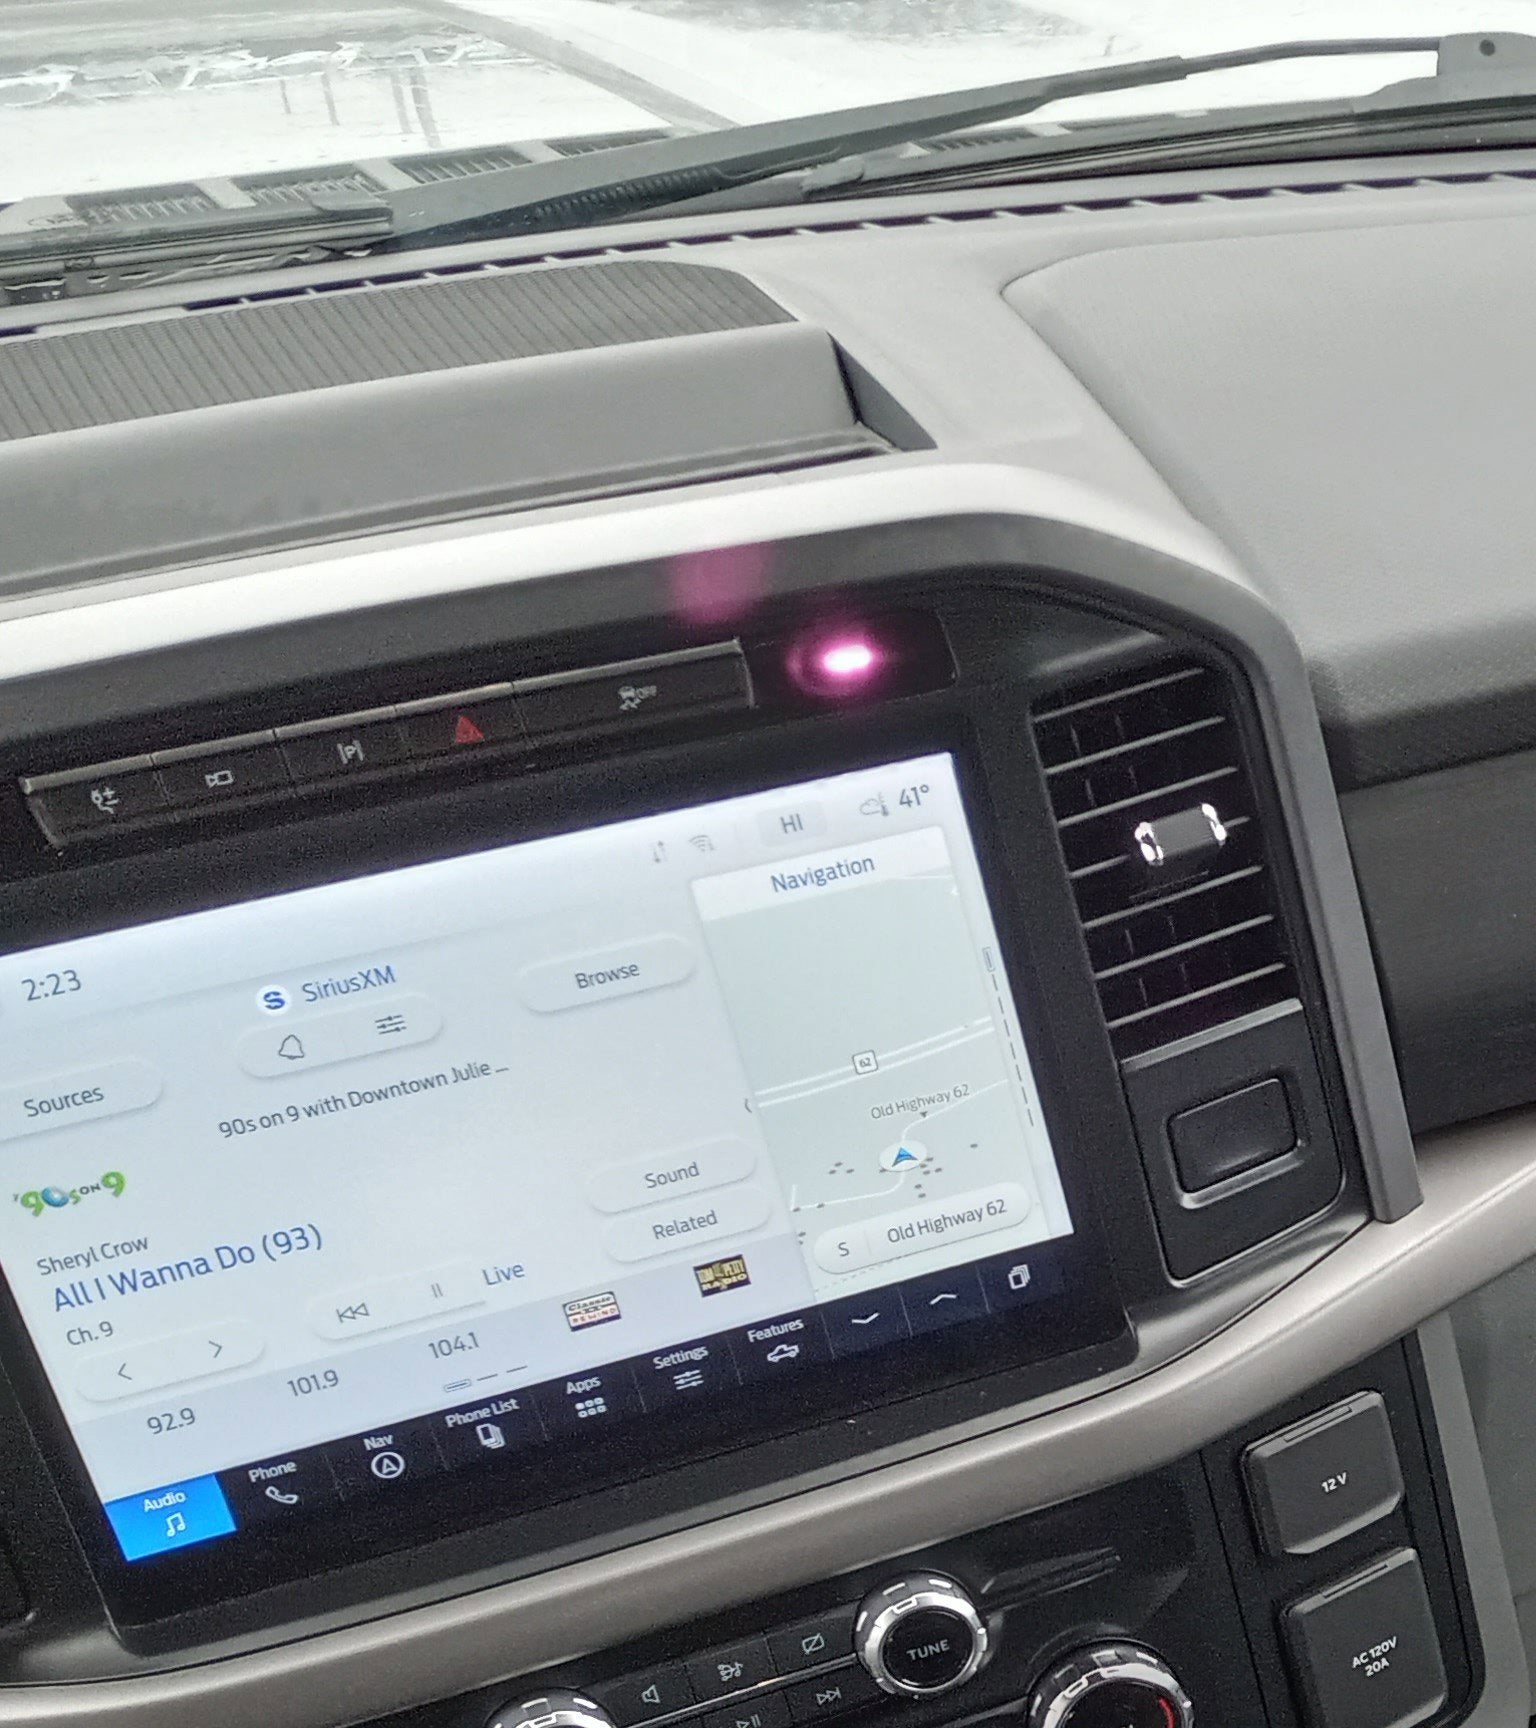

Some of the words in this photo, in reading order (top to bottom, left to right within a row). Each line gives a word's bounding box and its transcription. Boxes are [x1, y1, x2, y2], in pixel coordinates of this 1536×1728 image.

[780, 814, 805, 835] HI
[771, 855, 876, 894] Navigation
[22, 970, 82, 1002] 2:23
[301, 965, 396, 1003] SiriusXM
[575, 960, 640, 989] Browse
[24, 1084, 104, 1118] Sources
[218, 1117, 257, 1140] 90s
[259, 1110, 284, 1129] on
[286, 1104, 300, 1123] 9
[302, 1092, 346, 1119] with
[348, 1071, 448, 1108] Downtown
[451, 1060, 491, 1085] Julie
[870, 1104, 894, 1121] Old
[896, 1089, 951, 1116] Highway
[953, 1083, 970, 1099] 62
[644, 1162, 700, 1189] Sound
[652, 1210, 718, 1241] Related
[838, 1242, 850, 1257] S
[887, 1223, 916, 1245] Old
[917, 1206, 984, 1241] Highway
[986, 1198, 1006, 1217] 62
[36, 1246, 100, 1277] Sheryl
[100, 1233, 150, 1260] Crow
[53, 1280, 93, 1313] All
[94, 1276, 106, 1301] I
[108, 1256, 213, 1297] Wanna
[214, 1243, 256, 1270] Do
[262, 1223, 323, 1263] (93)
[482, 1261, 525, 1286] Live
[66, 1323, 100, 1347] Ch.
[100, 1320, 114, 1339] 9
[747, 1318, 804, 1343] Features
[429, 1332, 481, 1361] 104.1
[653, 1346, 709, 1371] Settings
[286, 1368, 339, 1398] 101.9
[566, 1375, 601, 1396] Apps
[147, 1407, 196, 1436] 92.9
[445, 1406, 490, 1428] Phone
[490, 1397, 519, 1419] List
[364, 1433, 393, 1451] Nav
[248, 1459, 297, 1484] Phone
[1321, 1479, 1336, 1493] 12
[1335, 1472, 1347, 1486] V
[143, 1490, 187, 1514] Audio
[906, 1639, 950, 1661] TUNE
[1351, 1651, 1369, 1669] AC
[1369, 1636, 1397, 1658] 120V
[1365, 1657, 1390, 1677] 20A
